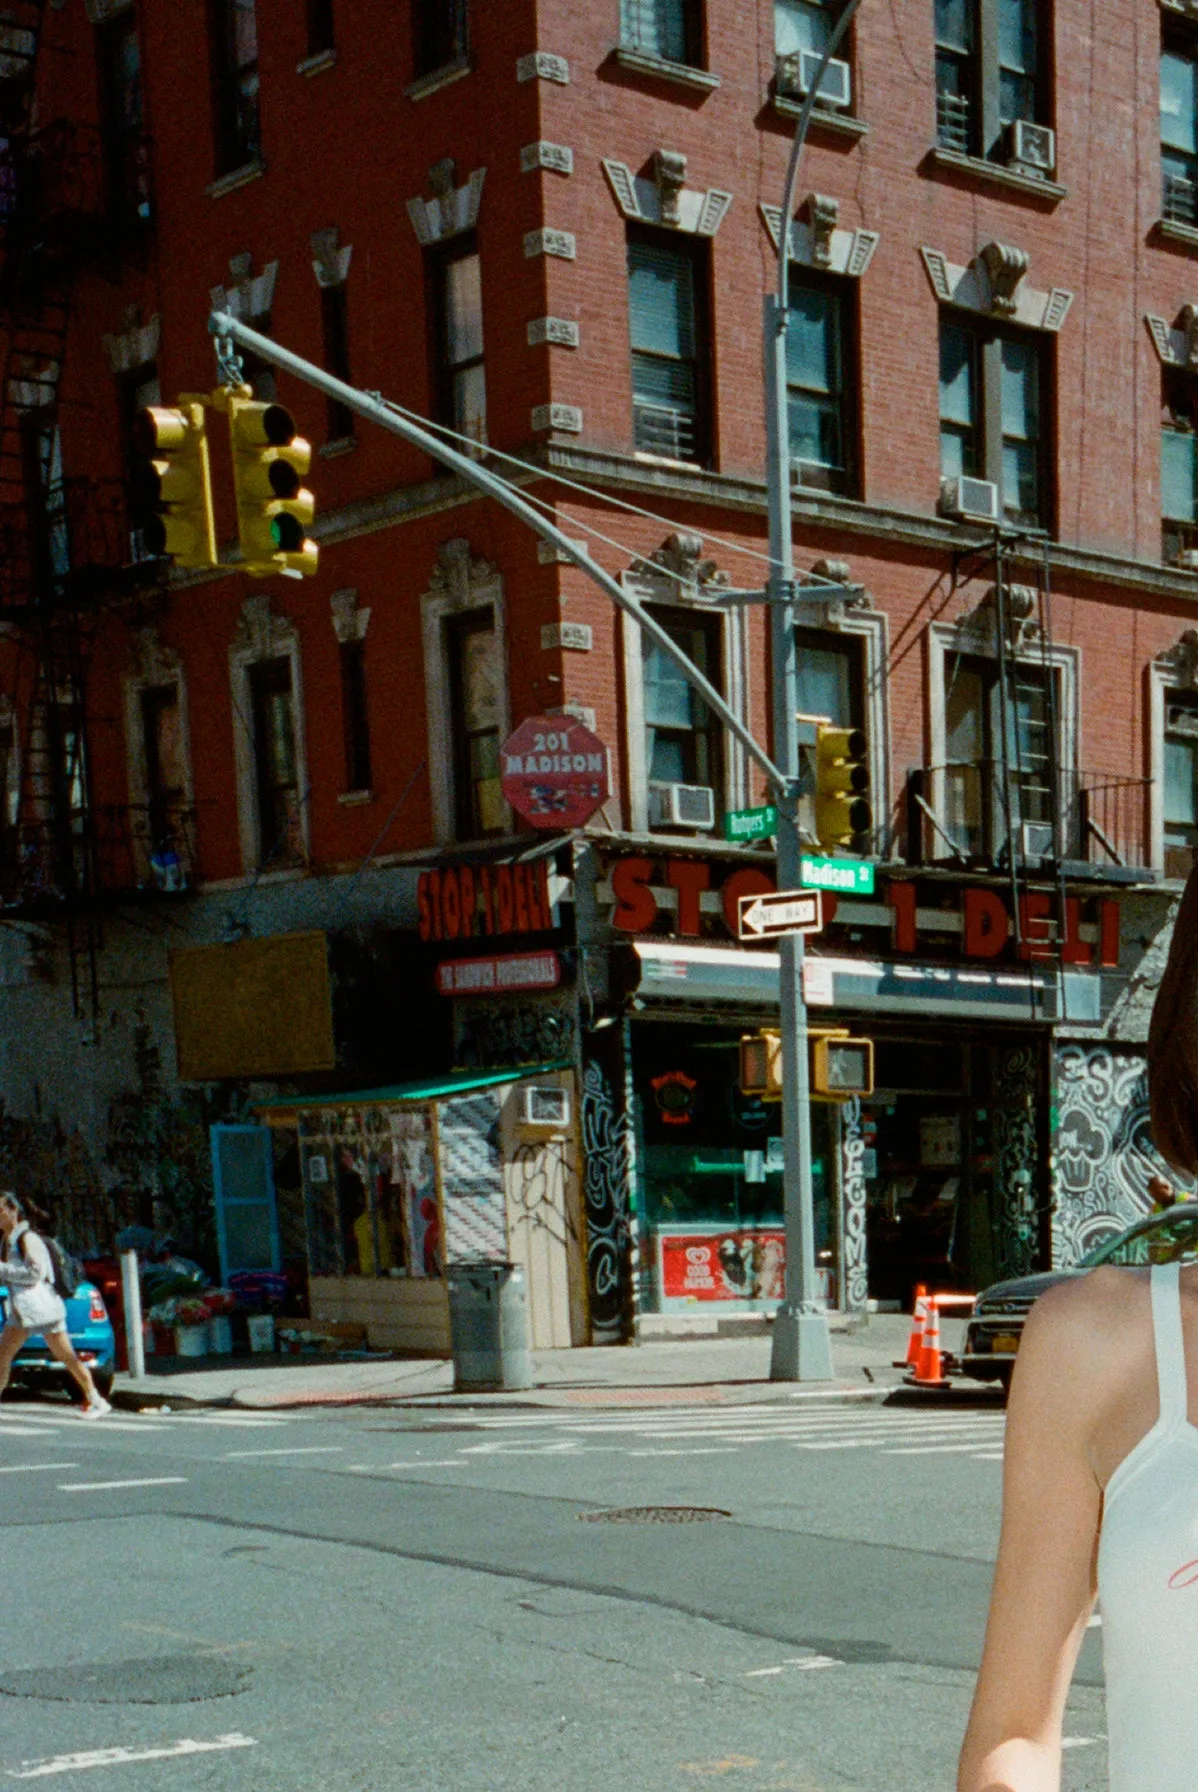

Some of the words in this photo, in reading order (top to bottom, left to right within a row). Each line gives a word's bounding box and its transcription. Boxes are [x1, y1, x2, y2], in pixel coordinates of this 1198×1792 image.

[533, 732, 570, 751] 201
[506, 753, 602, 774] MADISON
[730, 813, 765, 838] Rutgers
[802, 860, 856, 888] Madison
[417, 866, 476, 942] STOP
[480, 866, 494, 936] 1
[499, 860, 552, 934] DELI
[752, 907, 774, 924] ONE
[785, 903, 809, 920] WAY
[889, 881, 917, 952] 1
[963, 887, 1119, 967] DELI
